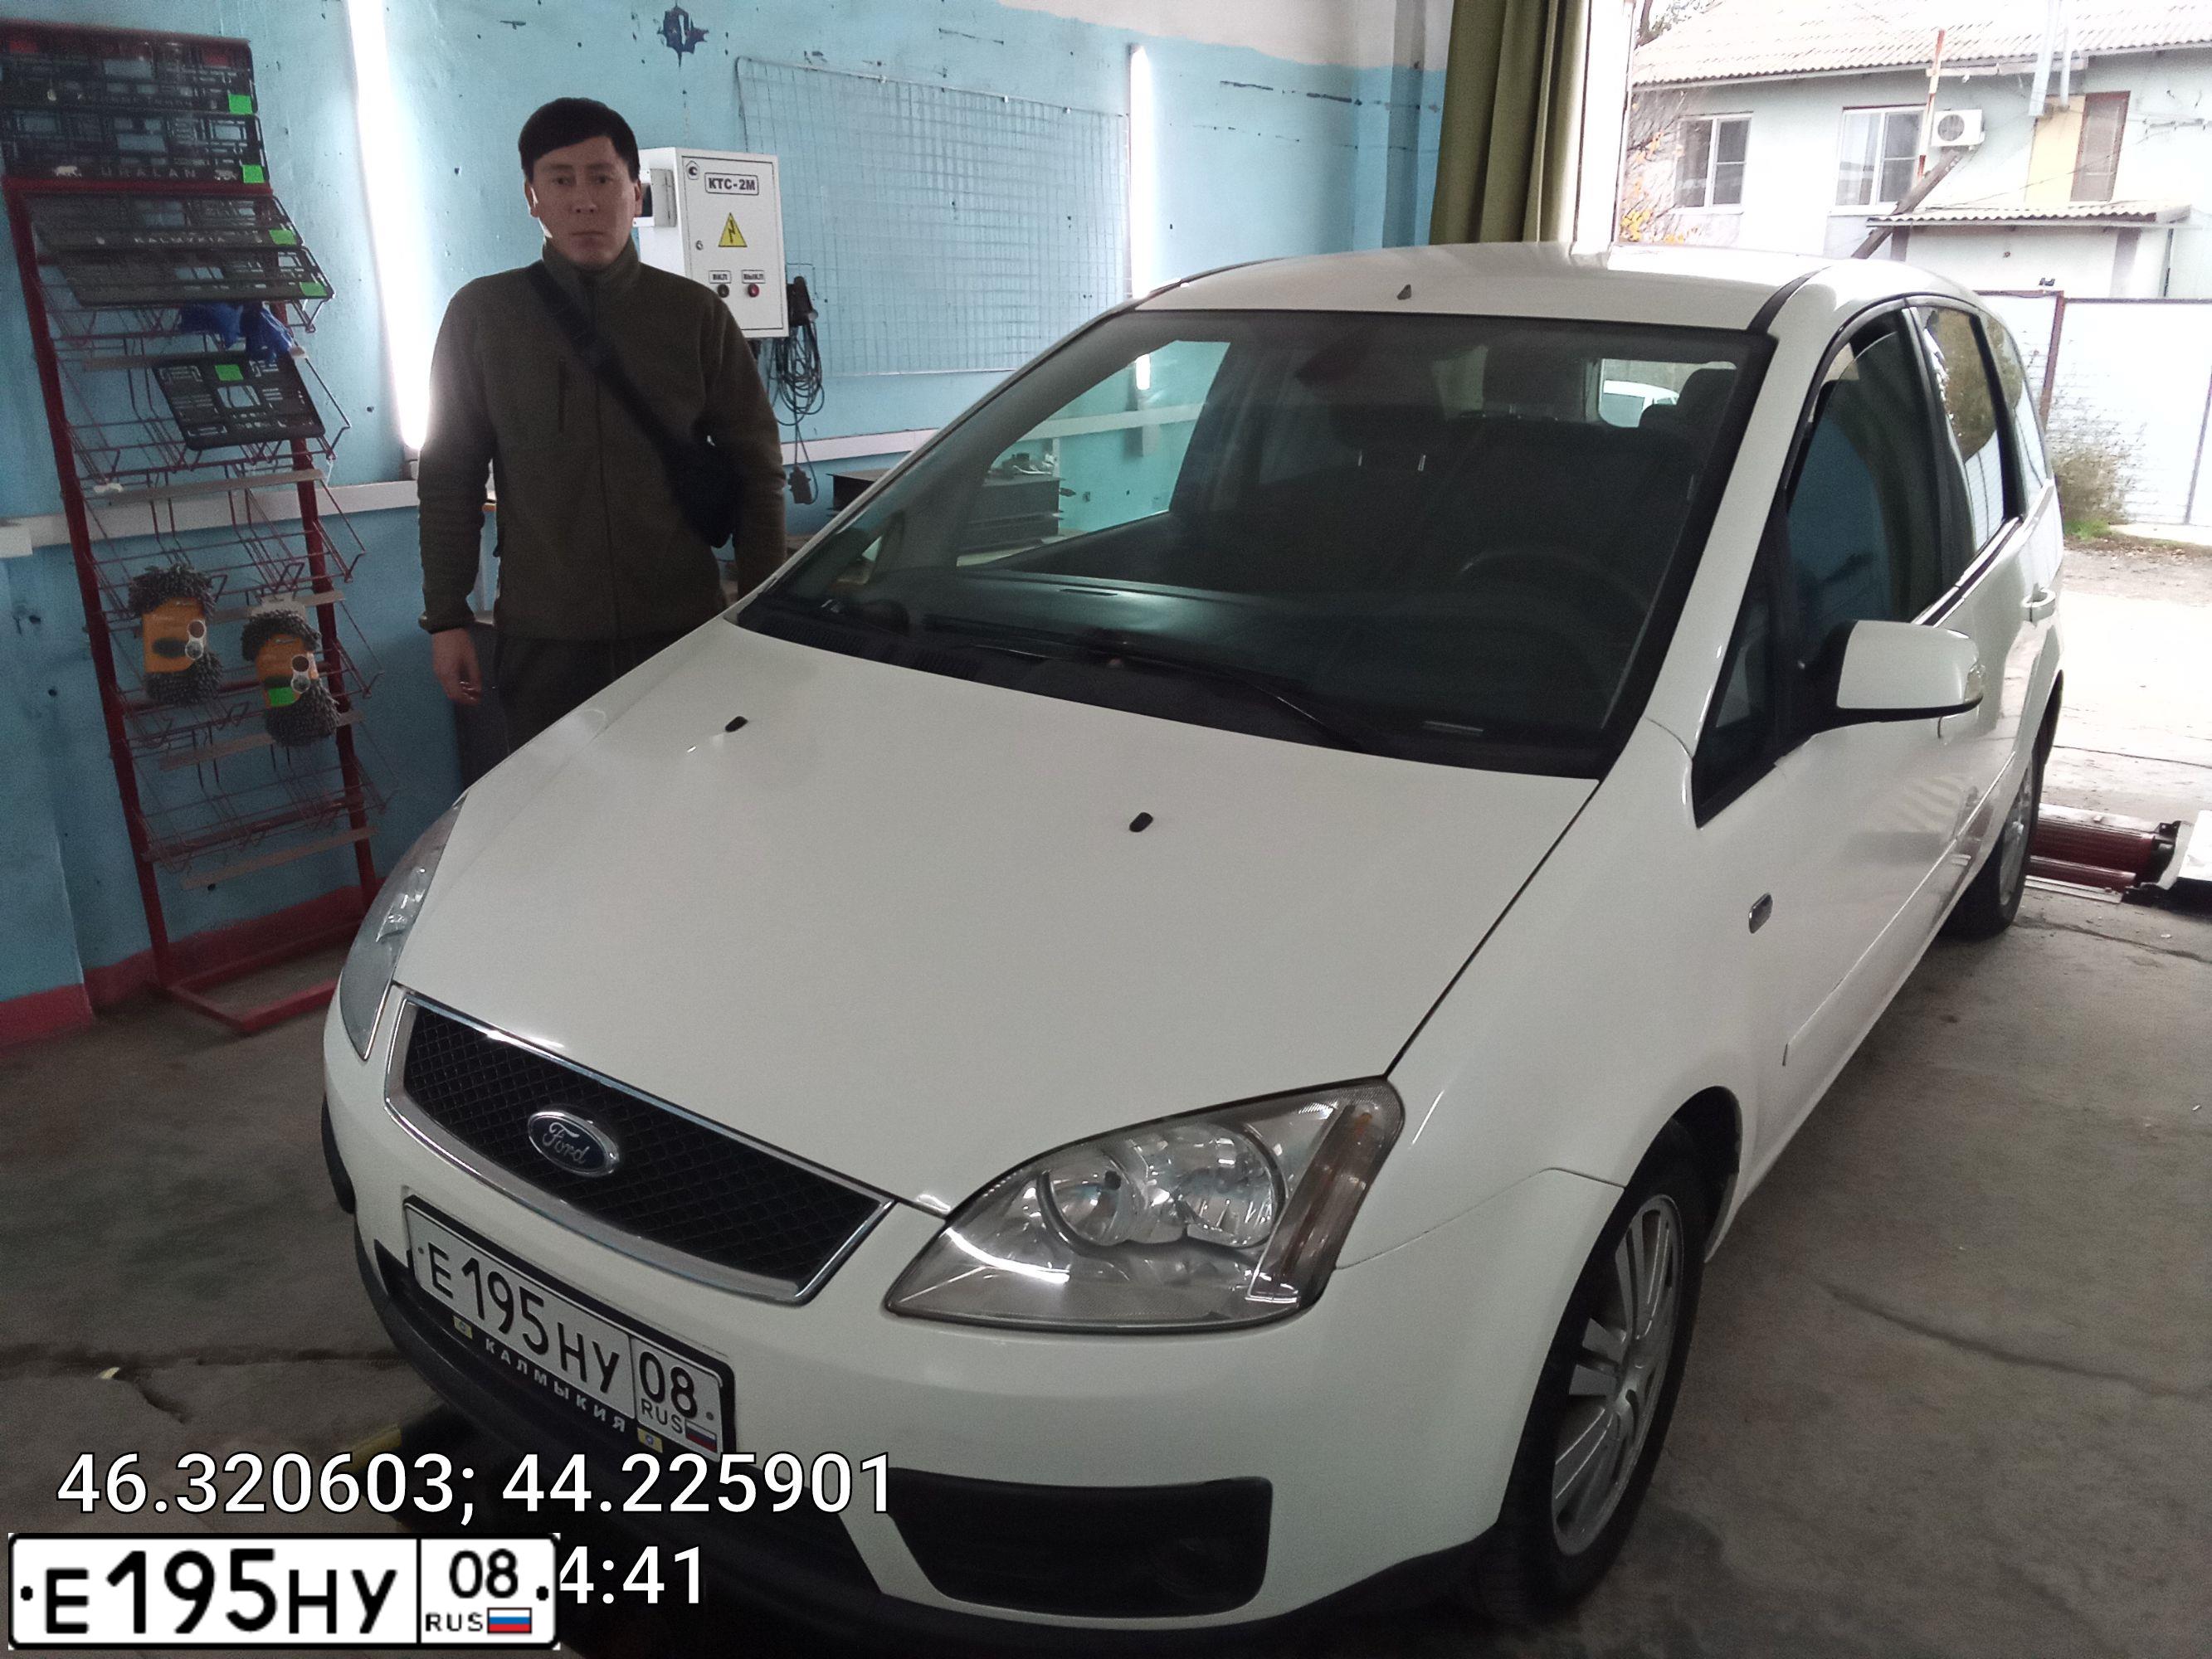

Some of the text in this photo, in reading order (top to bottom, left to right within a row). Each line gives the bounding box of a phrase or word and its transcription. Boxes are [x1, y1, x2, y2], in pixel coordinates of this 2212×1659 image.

[707, 178, 756, 190] КТС-2М
[542, 1121, 590, 1165] Ford
[485, 1338, 626, 1433] КАЛМЫКИЯ
[639, 1350, 698, 1419] 08
[641, 1398, 683, 1434] RUS
